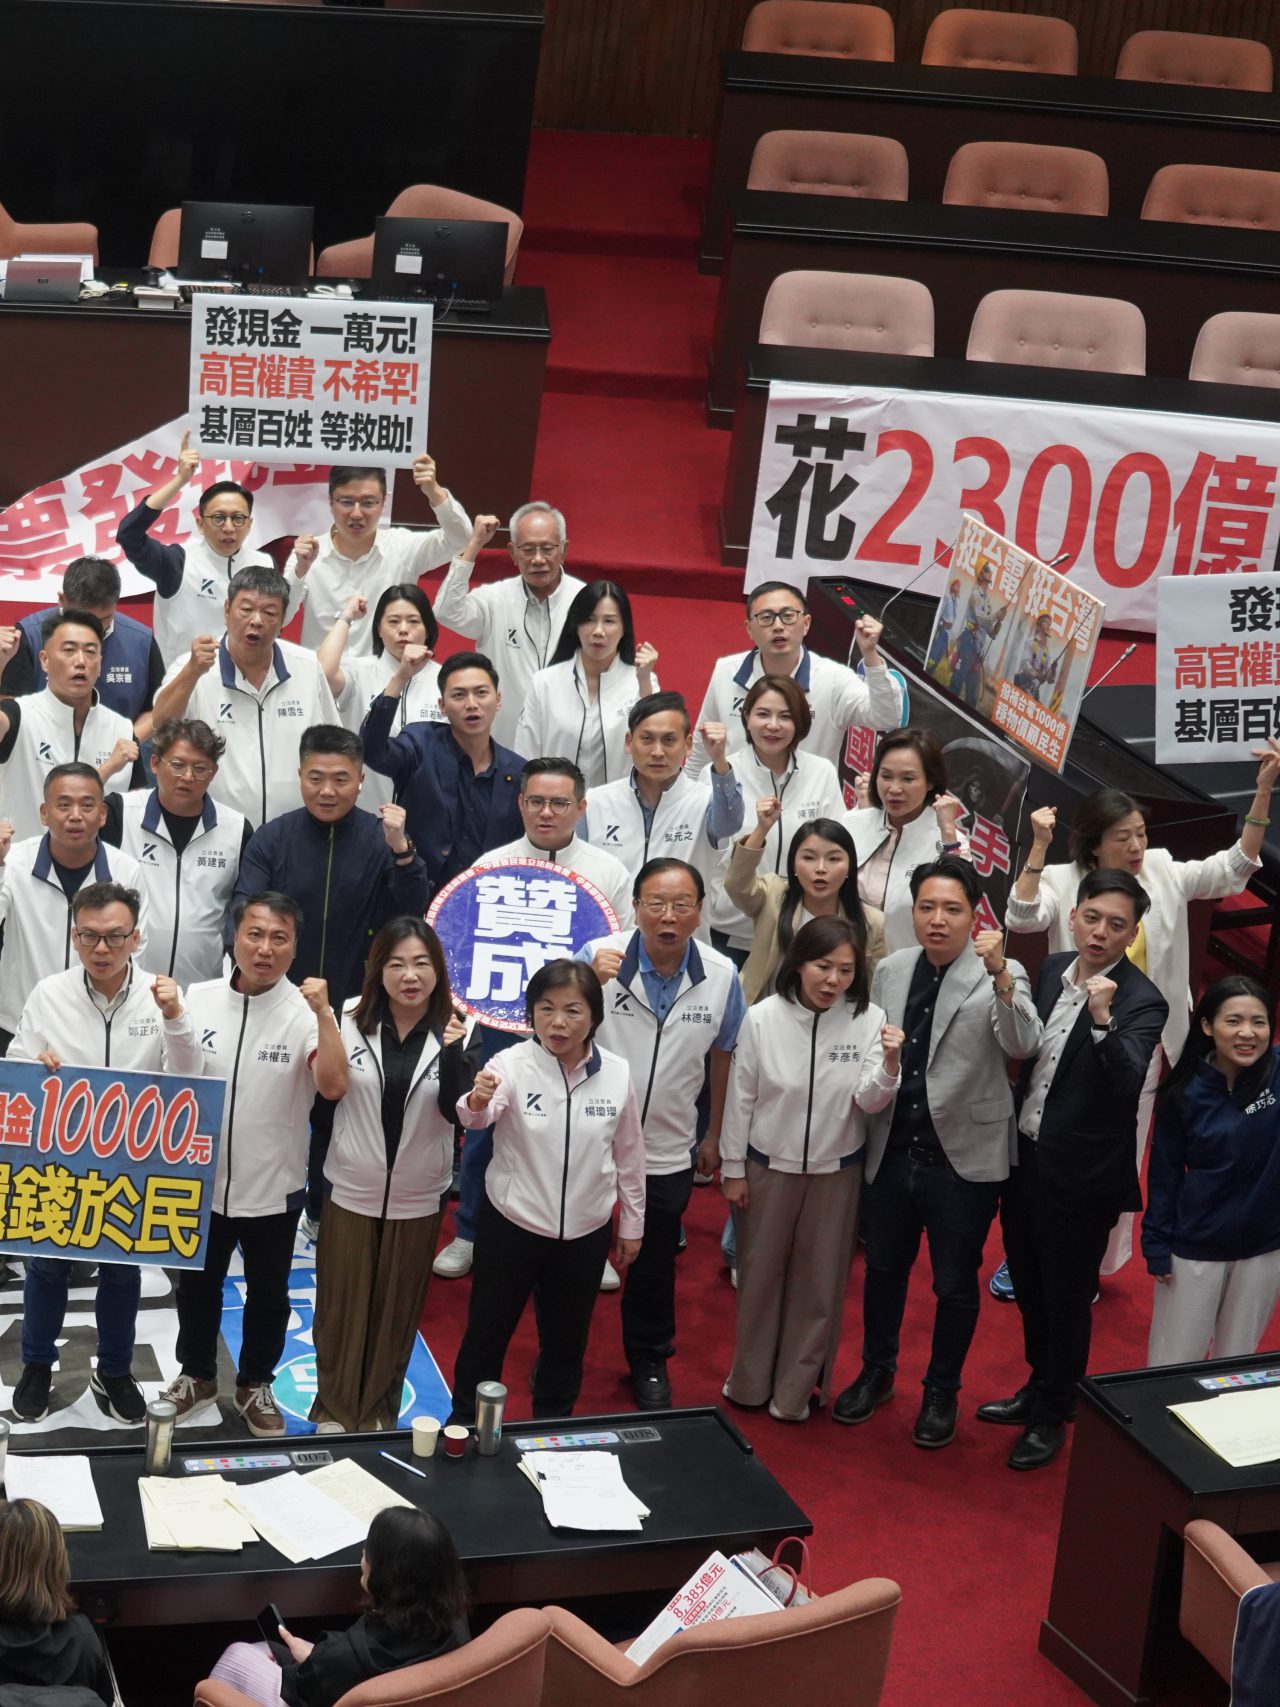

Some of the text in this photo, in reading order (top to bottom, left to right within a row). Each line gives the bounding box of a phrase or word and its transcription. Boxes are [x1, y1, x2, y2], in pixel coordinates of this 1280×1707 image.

[205, 306, 417, 354] 發現金 一萬元!
[199, 351, 419, 405] 高官權貴 不希罕!
[199, 405, 413, 453] 基層百姓 等救助!
[766, 413, 1278, 590] 花2300億
[1228, 586, 1280, 633] 發
[1174, 640, 1280, 690] 高官權
[1174, 696, 1280, 744] 基層百
